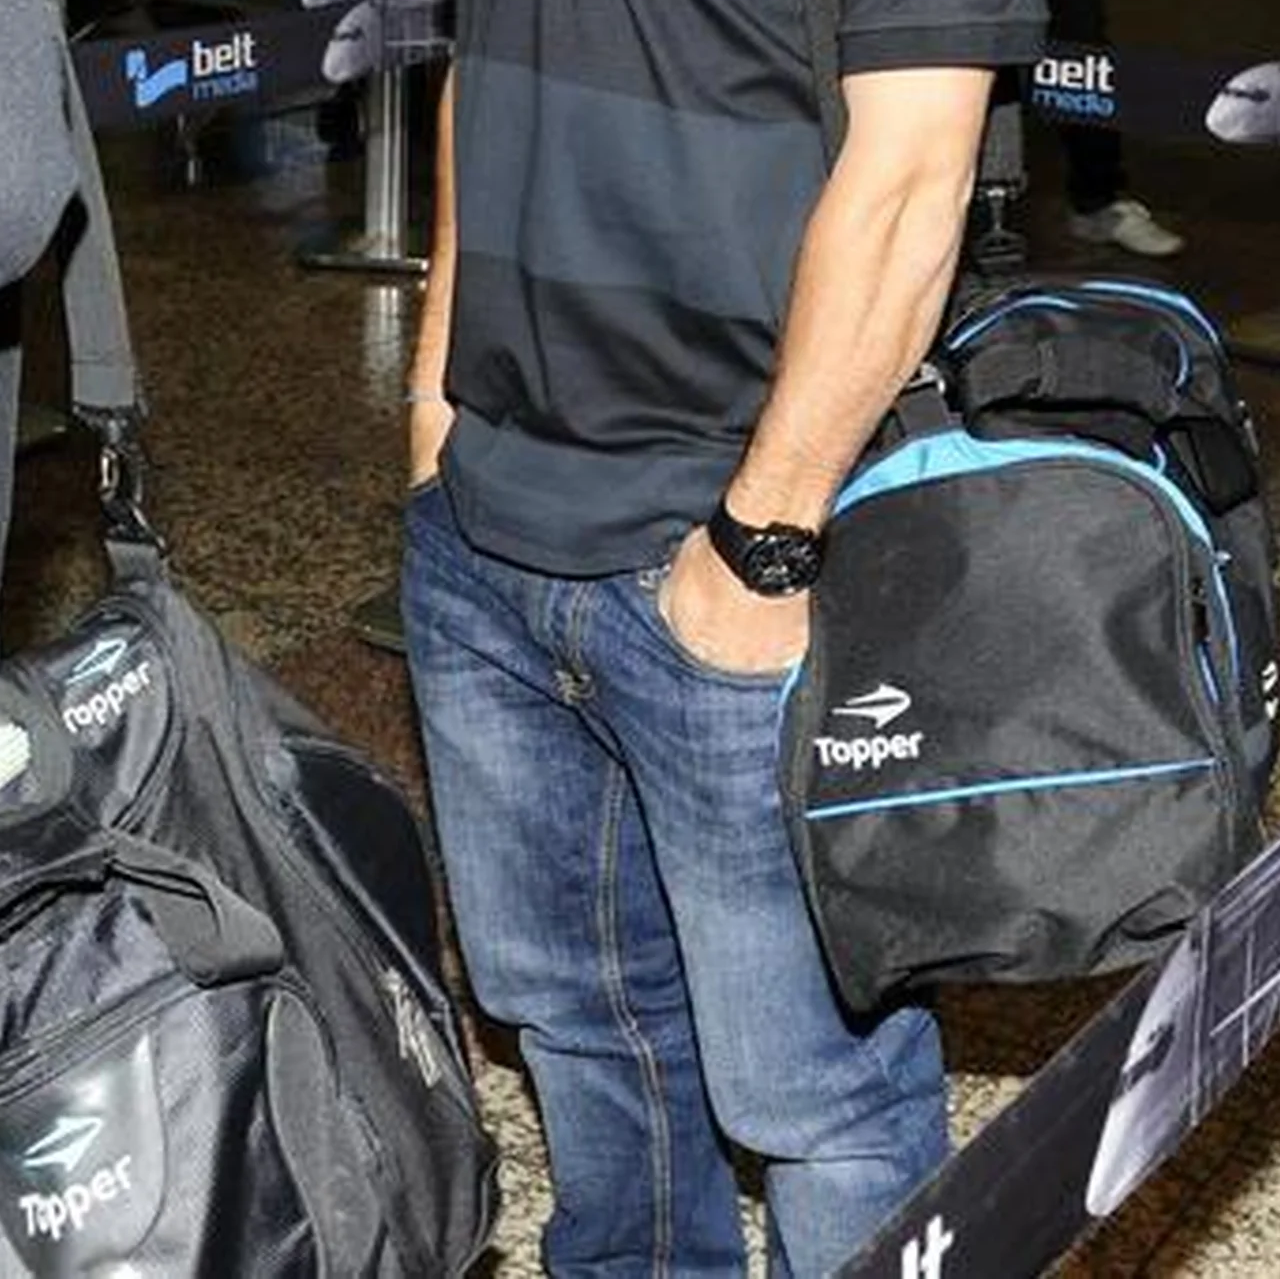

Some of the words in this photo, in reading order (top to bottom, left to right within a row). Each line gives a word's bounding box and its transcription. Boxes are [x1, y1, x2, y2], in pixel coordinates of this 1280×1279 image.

[192, 31, 256, 78] belt
[192, 71, 259, 100] media
[813, 731, 924, 771] Topper
